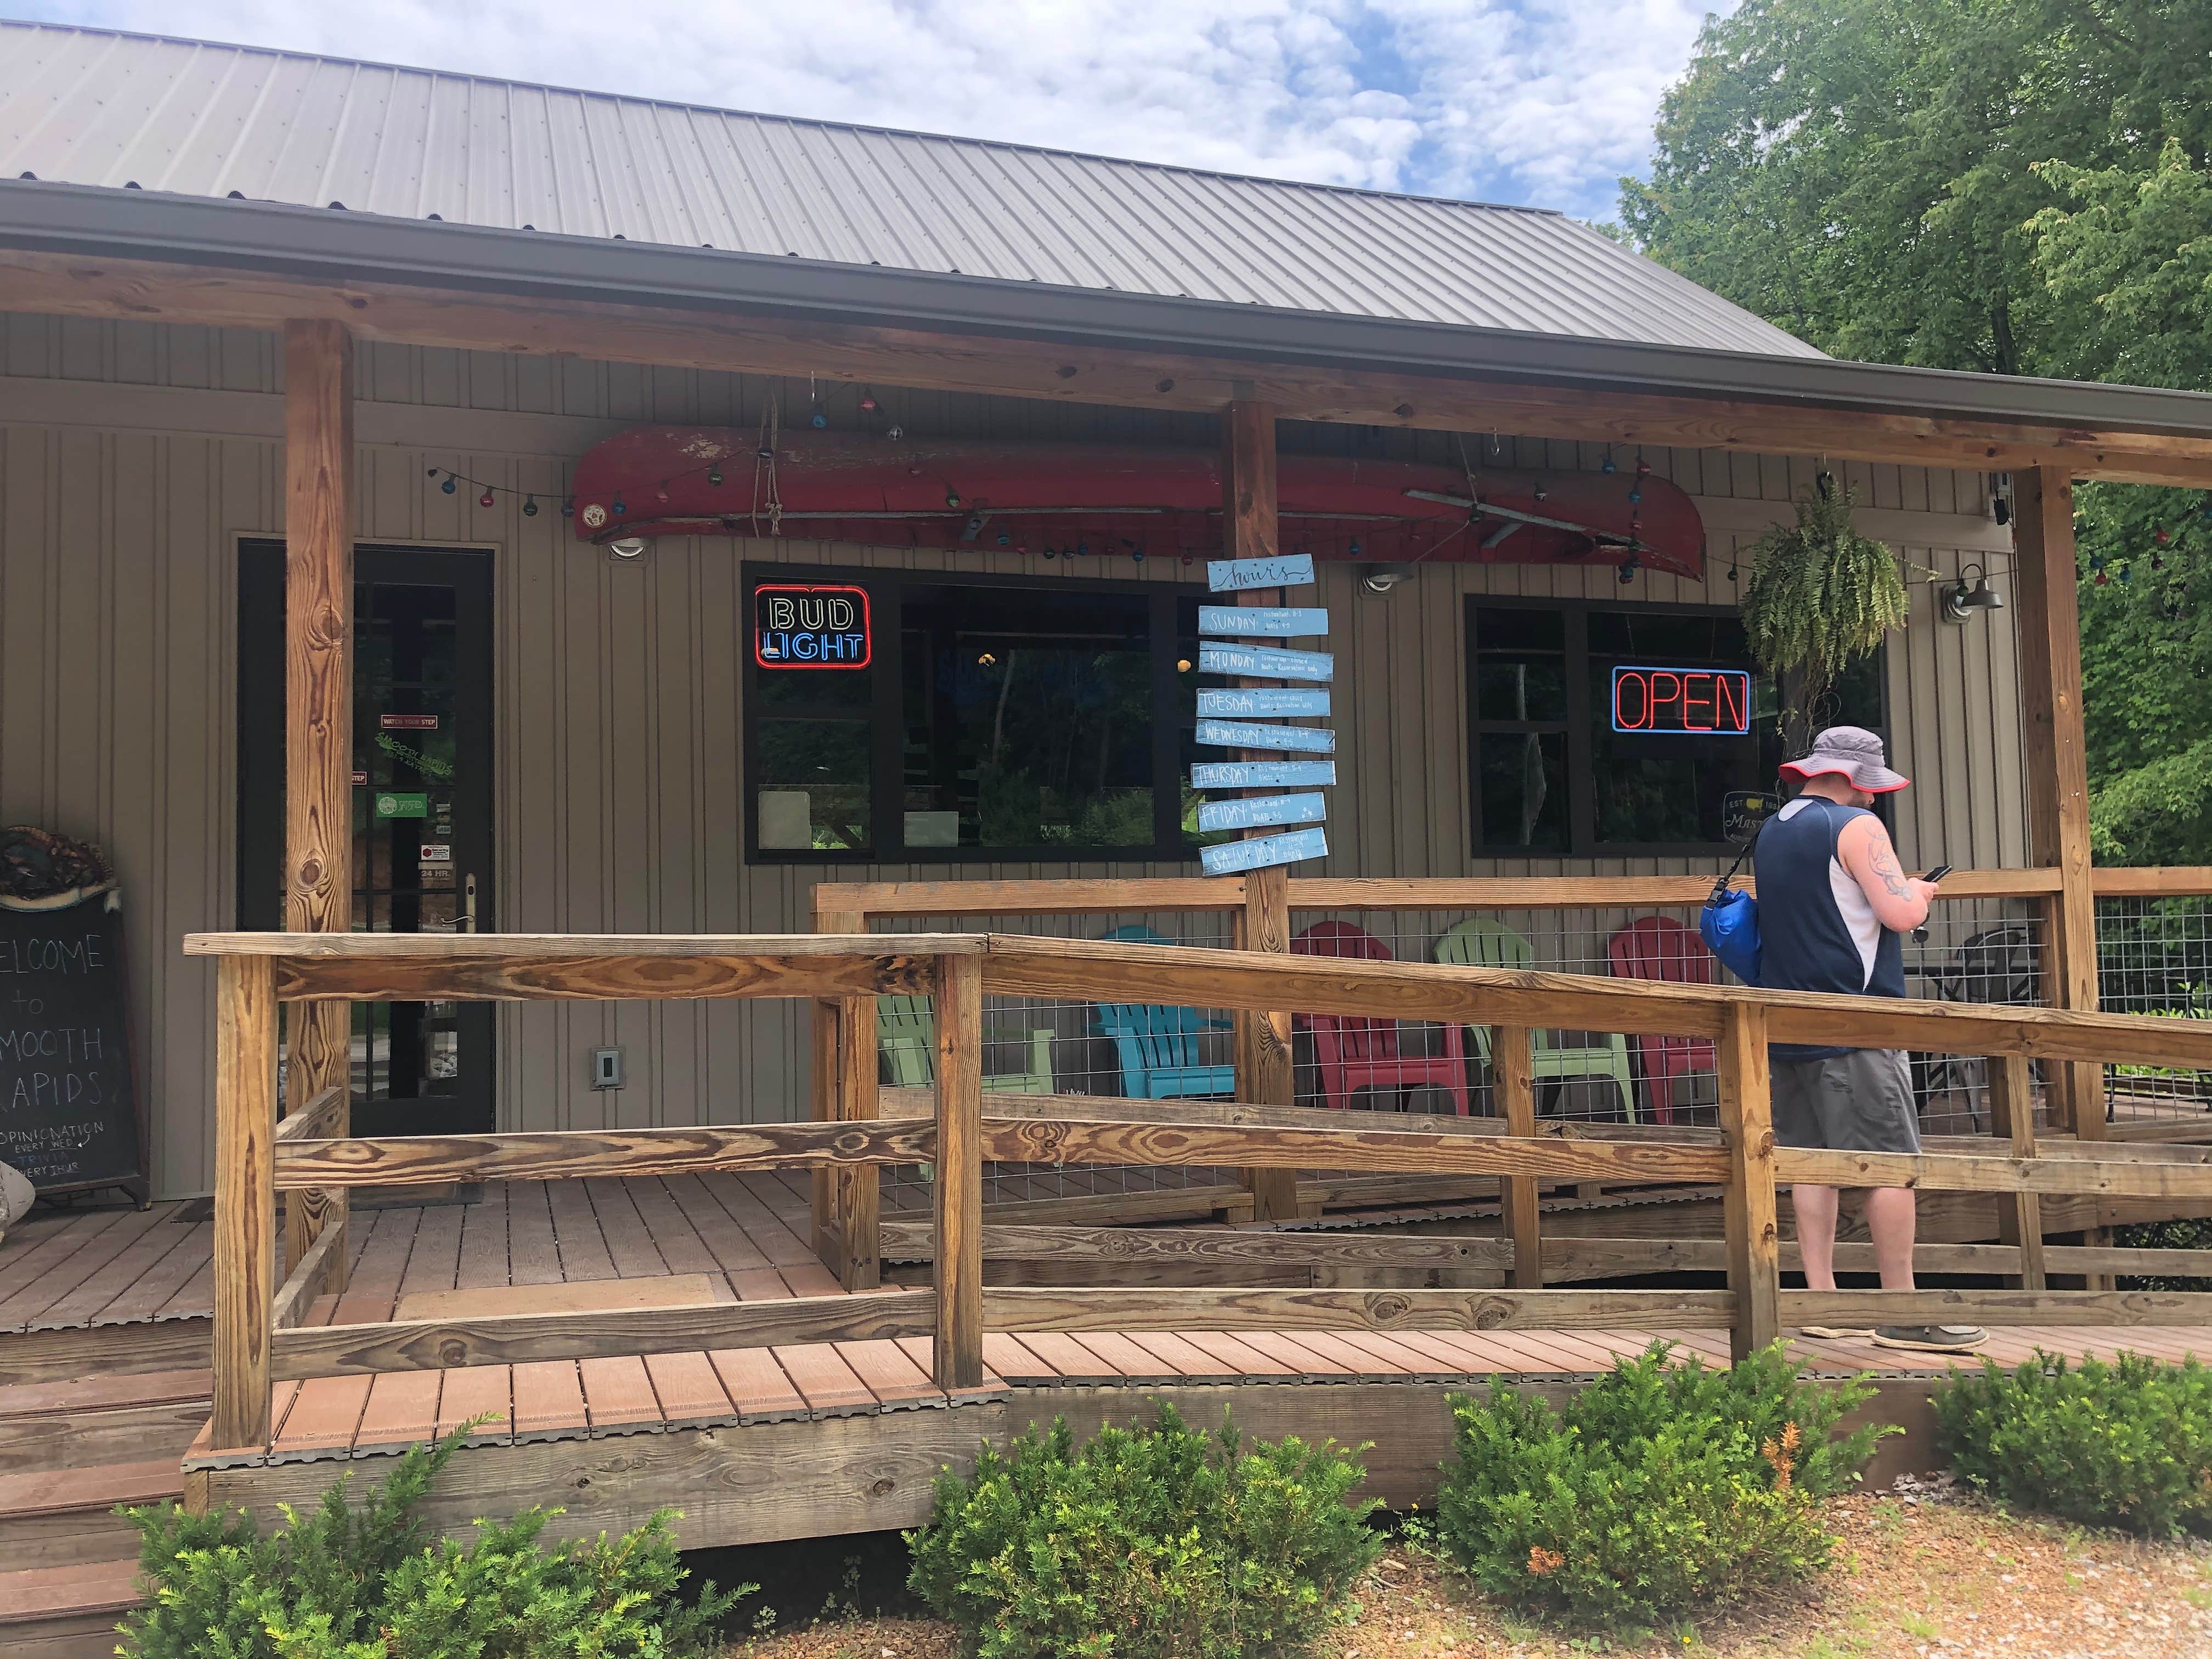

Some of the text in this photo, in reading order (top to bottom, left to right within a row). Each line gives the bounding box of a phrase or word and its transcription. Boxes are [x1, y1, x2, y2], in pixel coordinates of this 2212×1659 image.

[769, 597, 854, 630] BUD
[1209, 612, 1256, 631] SUNDAY
[762, 631, 864, 661] LIGHT
[1209, 651, 1255, 670] MONDAY
[1199, 693, 1254, 713] TUESDAY
[1617, 673, 1745, 730] OPEN
[1205, 724, 1260, 745] WEDNESDAY
[1194, 766, 1249, 784] THURSDAY
[1200, 804, 1246, 827] FRIDAY
[1212, 842, 1277, 871] SATURDAY
[0, 934, 104, 975] ELCOME
[11, 989, 44, 1014] to
[0, 1028, 102, 1064] MOOTH
[0, 1072, 103, 1112] APIDS
[15, 1138, 74, 1153] EVERY WED
[50, 1162, 80, 1176] THUR
